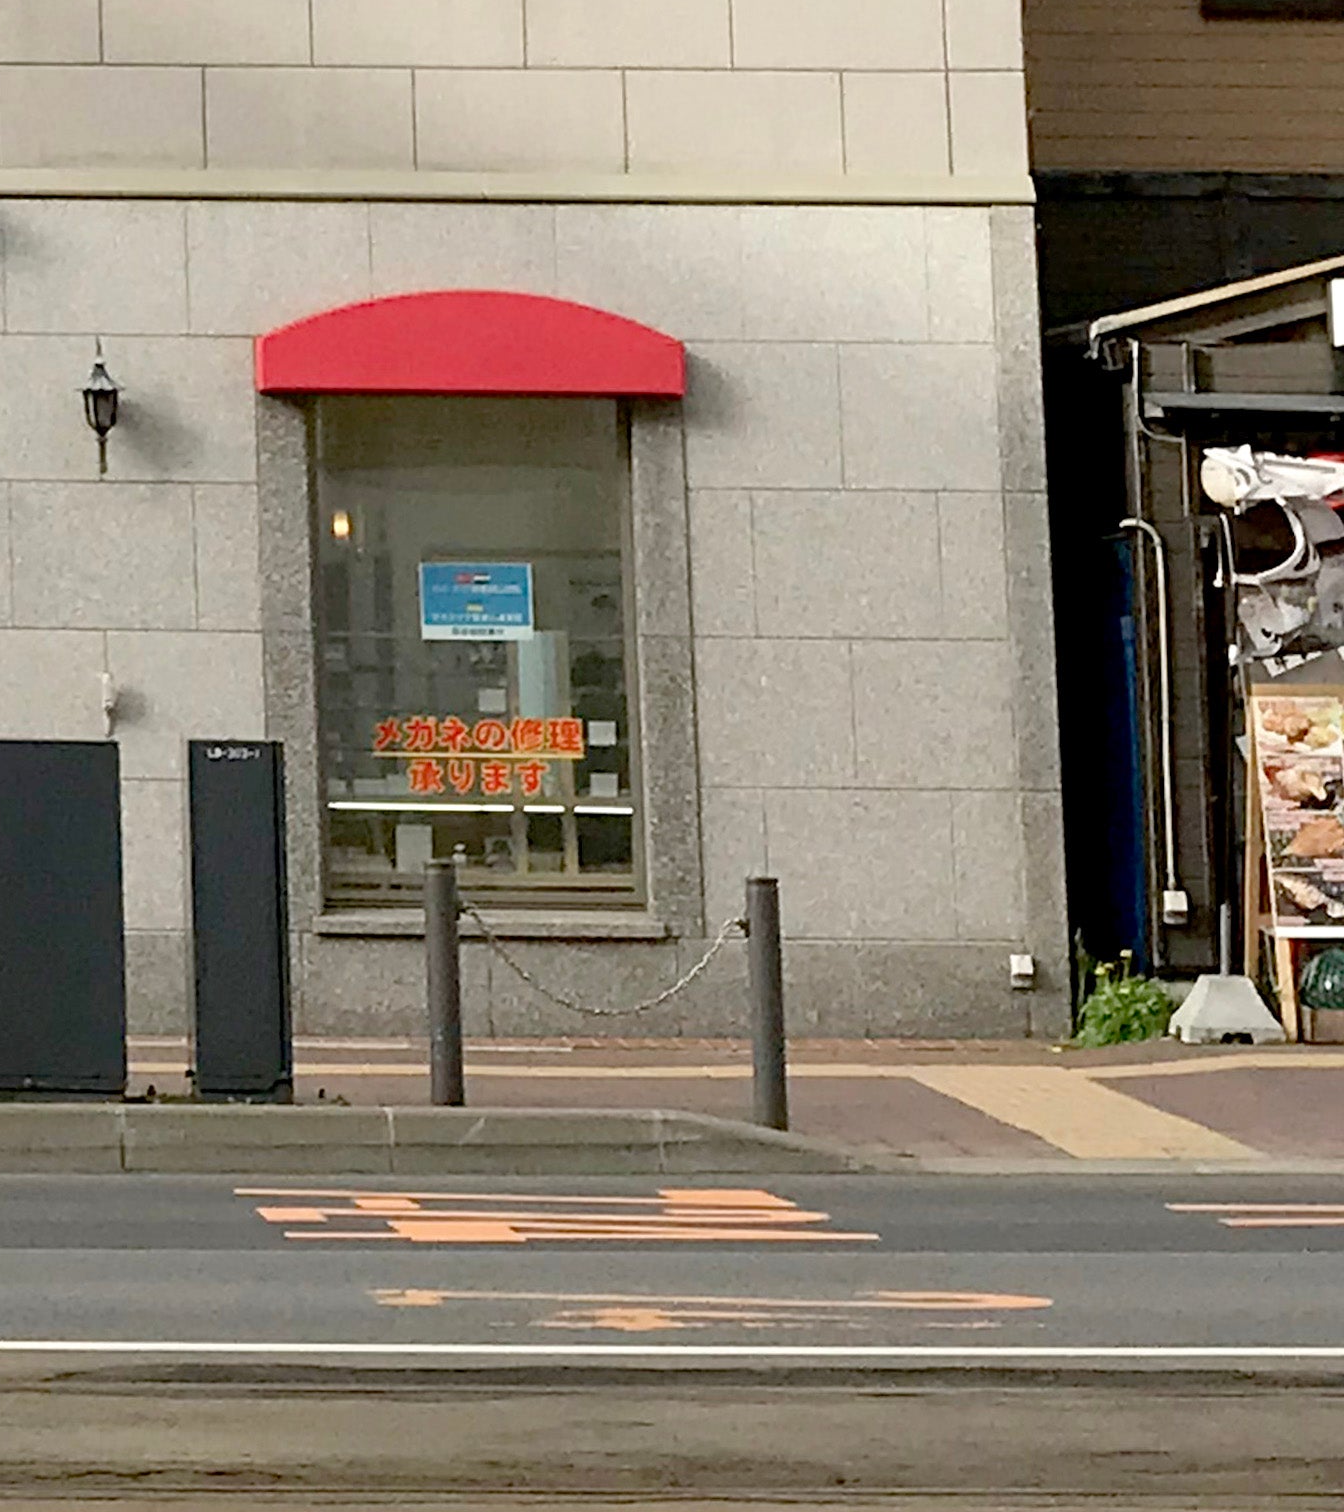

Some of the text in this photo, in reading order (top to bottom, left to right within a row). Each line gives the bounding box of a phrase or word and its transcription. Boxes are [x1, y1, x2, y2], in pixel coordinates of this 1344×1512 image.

[373, 715, 585, 753] メガネの修理
[408, 758, 550, 794] 承ります
